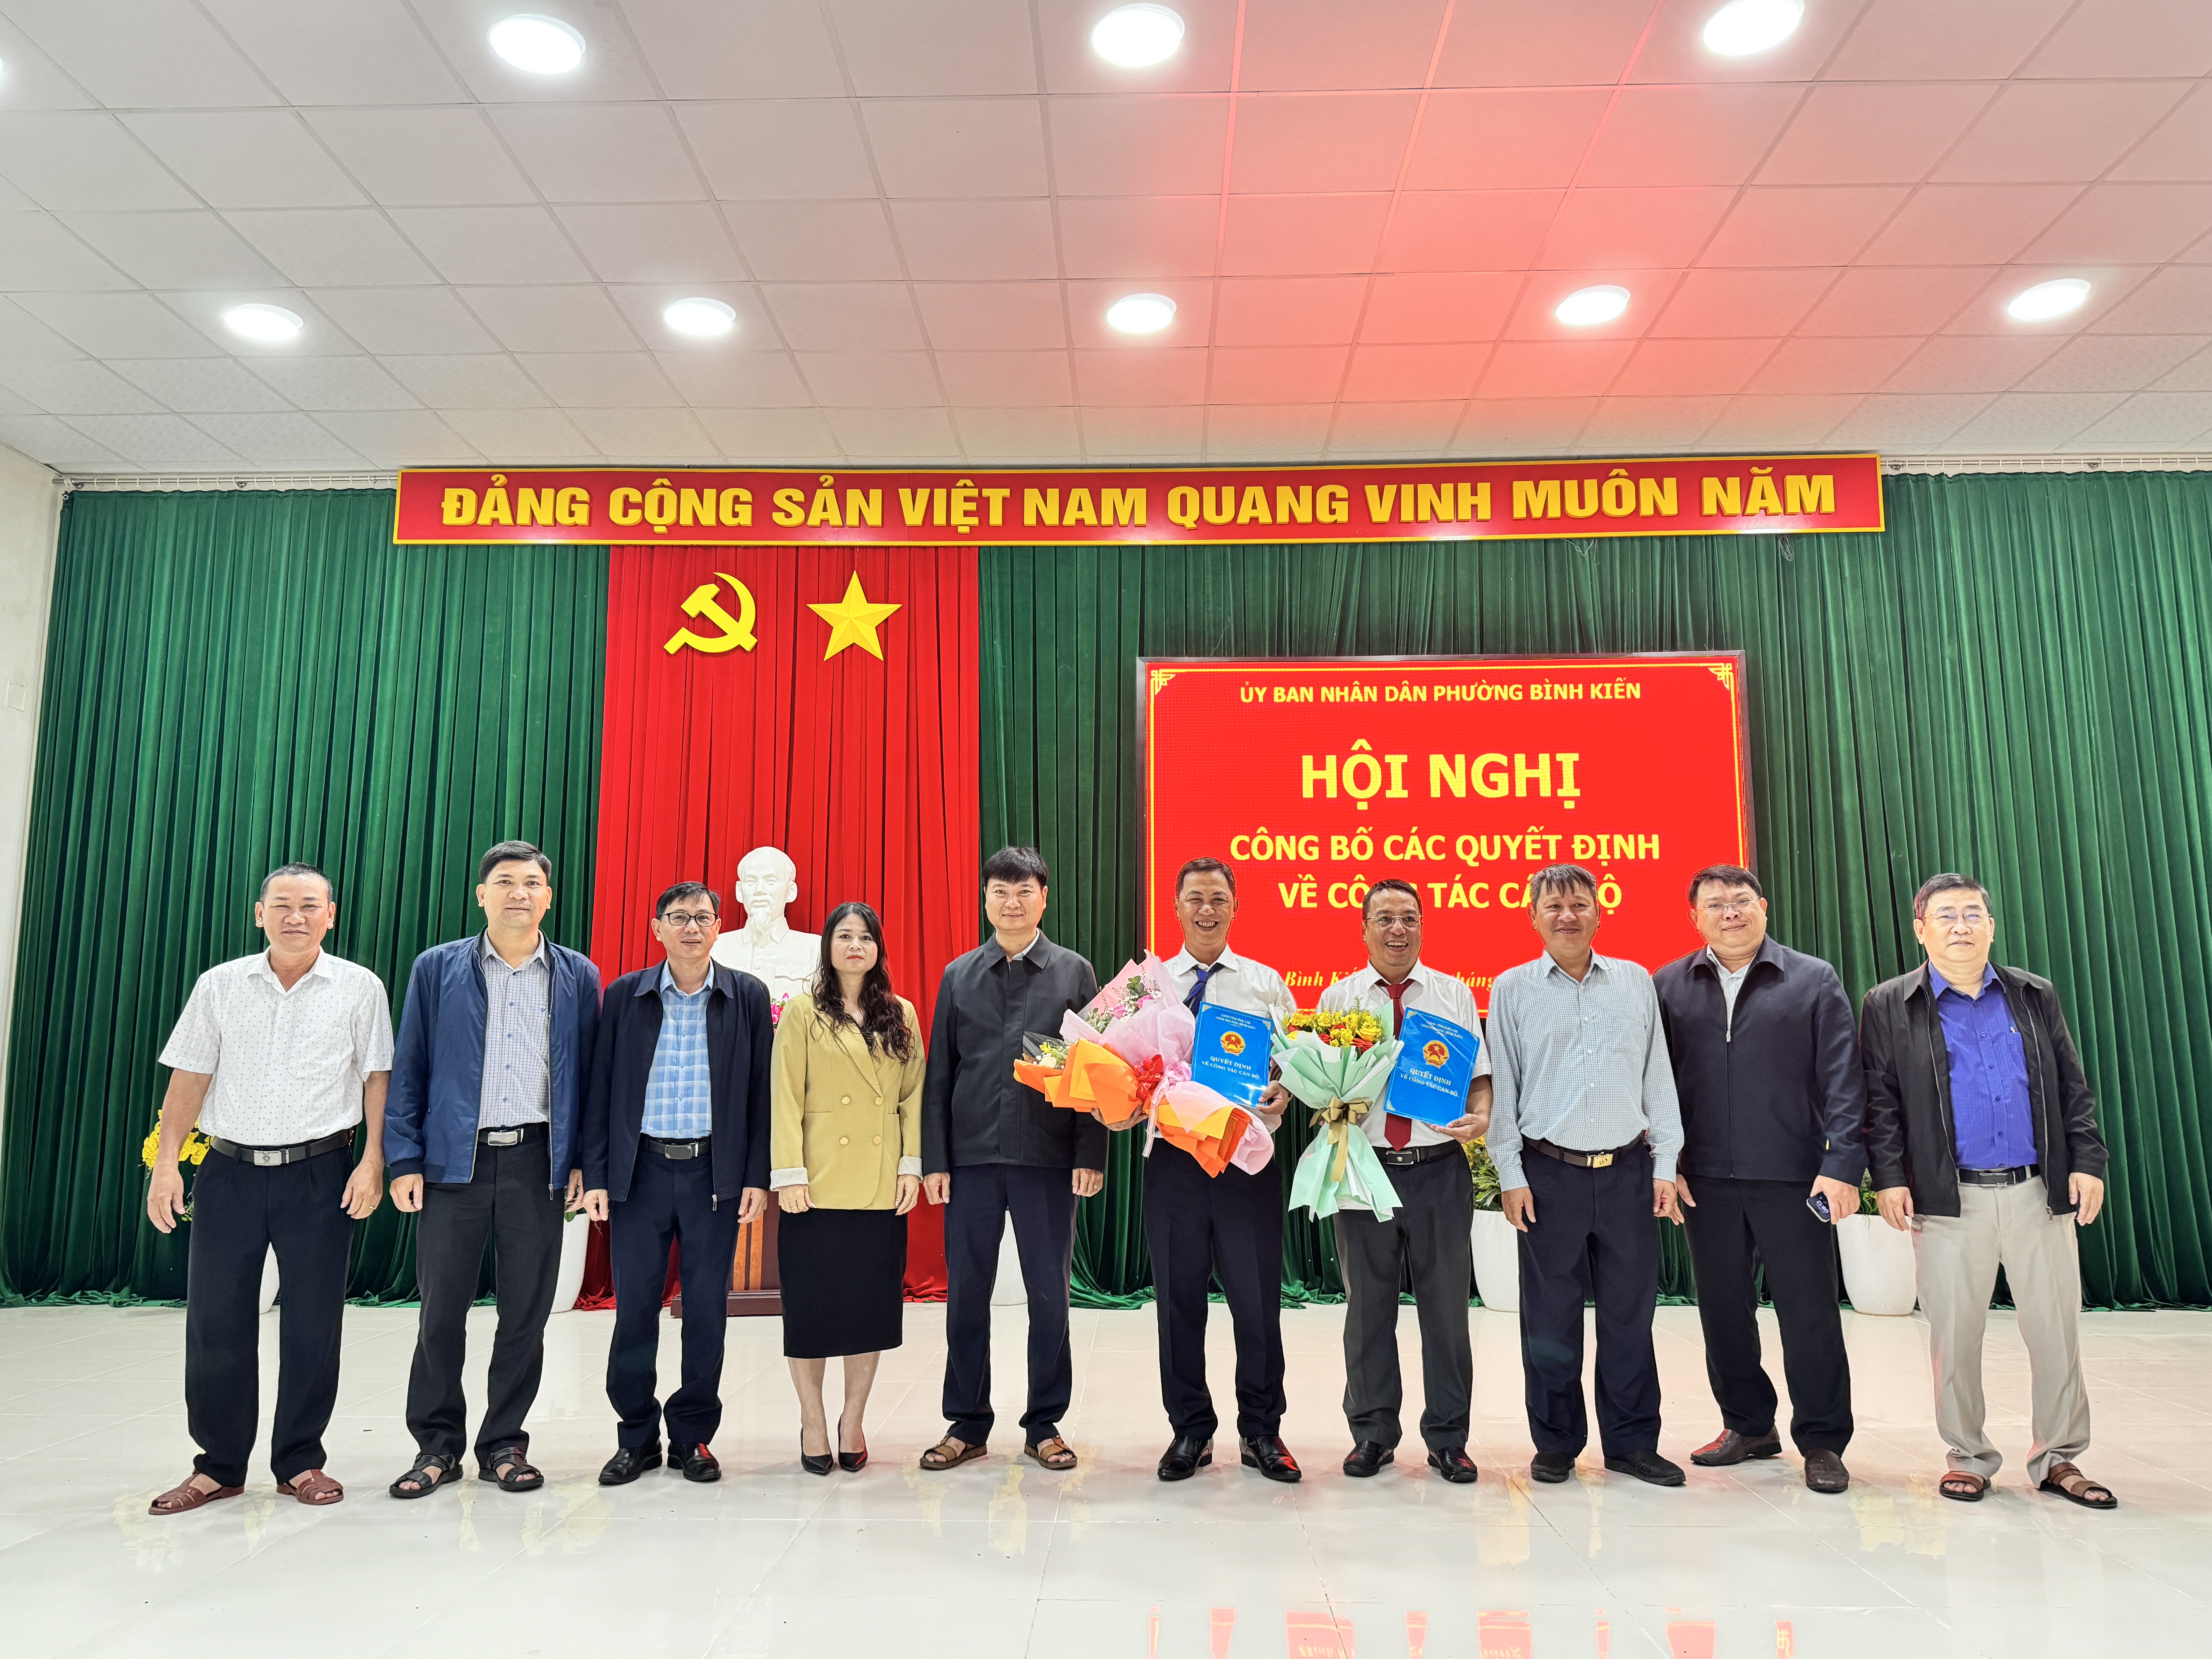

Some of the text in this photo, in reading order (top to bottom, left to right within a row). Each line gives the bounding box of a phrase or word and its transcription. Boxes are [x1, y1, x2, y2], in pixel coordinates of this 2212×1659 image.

[441, 466, 1836, 534] ĐẢNG CỘNG SẢN VIỆT NAM QUANG VINH MUÔN NĂM
[1240, 677, 1641, 703] ỦY BAN NHÂN DÂN PHƯỜNG BÌNH KIẾN
[1302, 738, 1581, 810] HỘI NGHỊ
[1230, 825, 1660, 867] CÔNG BỐ CÁC QUYẾT ĐỊNH
[1278, 874, 1318, 908] VỀ
[1328, 874, 1418, 909] CÔ
[1427, 874, 1490, 909] TÁC
[1595, 873, 1623, 915] Ộ
[1285, 971, 1324, 988] Bình
[1454, 971, 1493, 992] háng
[1210, 1055, 1251, 1071] QUYẾT ĐỊNH
[1410, 1068, 1451, 1086] QUYẾT ĐỊNH
